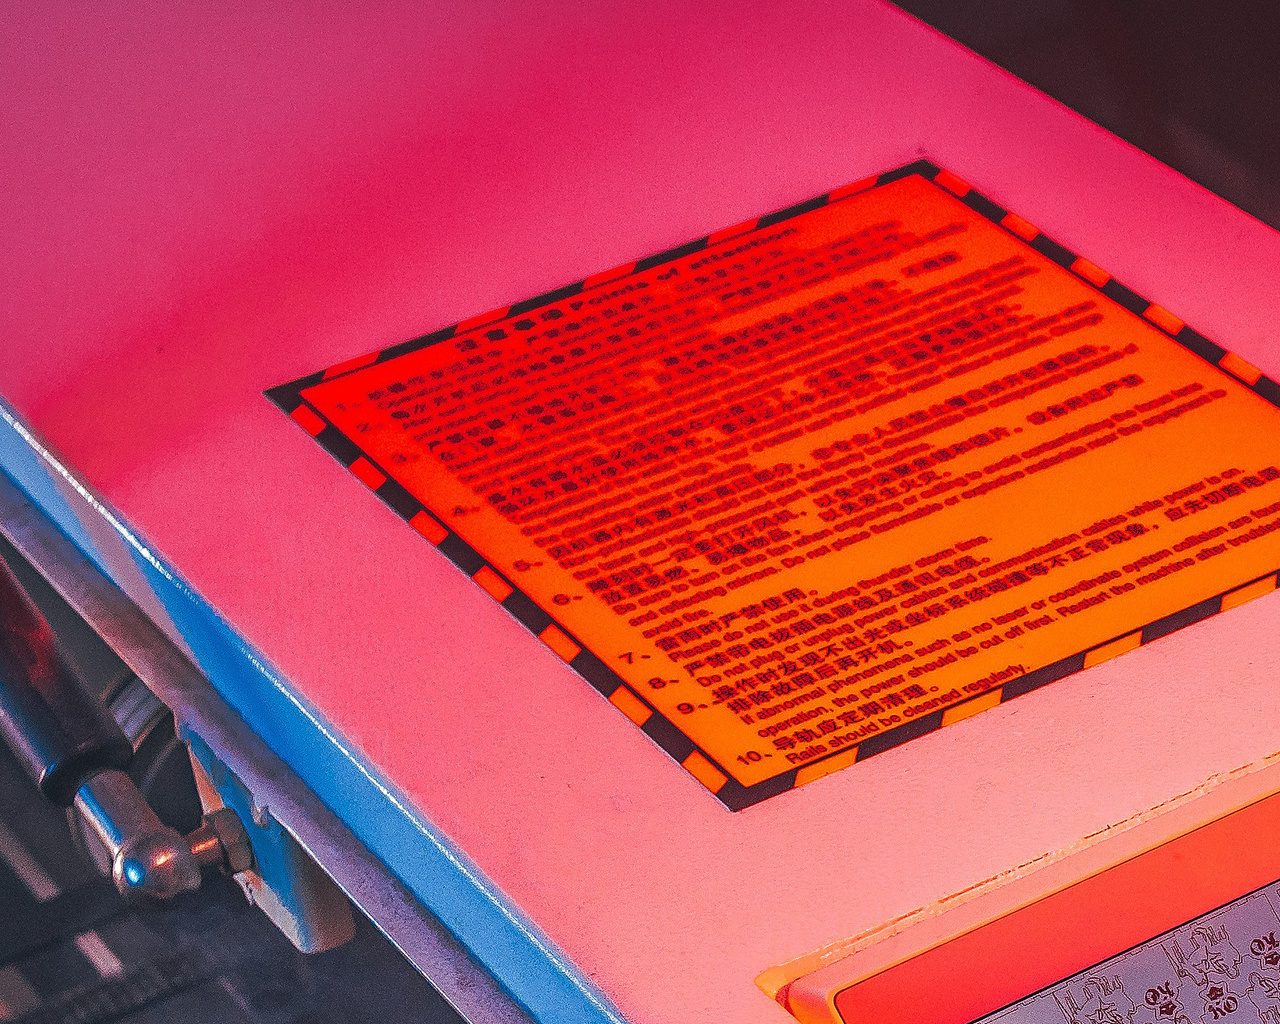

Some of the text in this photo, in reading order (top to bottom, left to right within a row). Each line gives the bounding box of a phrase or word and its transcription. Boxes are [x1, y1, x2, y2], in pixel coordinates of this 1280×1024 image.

[655, 266, 681, 281] of
[640, 608, 715, 639] avoid fire.
[666, 534, 994, 663] Please do not use it during thunder storm time.
[694, 466, 1248, 688] Do not plug or unplug power cables and communication cables while power is on.
[738, 712, 755, 726] If
[755, 685, 828, 720] abnormal
[825, 652, 916, 694] phenomena
[912, 637, 952, 658] such
[950, 629, 973, 643] as
[970, 620, 993, 634] no
[989, 605, 1030, 626] laser
[1029, 598, 1048, 611] or
[1046, 568, 1123, 604] coordinate
[1120, 547, 1174, 574] system
[1171, 525, 1229, 553] collision
[1226, 514, 1253, 530] are
[756, 704, 835, 738] operation,
[830, 692, 860, 708] the
[858, 672, 906, 700] power
[905, 651, 958, 679] should
[953, 644, 980, 659] be
[978, 633, 1005, 650] cut
[1002, 623, 1025, 640] off
[1021, 613, 1055, 631] first.
[1050, 590, 1113, 622] Restart
[1107, 581, 1137, 596] the
[1134, 556, 1196, 586] machine
[1193, 542, 1228, 561] after
[783, 662, 1032, 768] Rails should be cleaned regularly.
